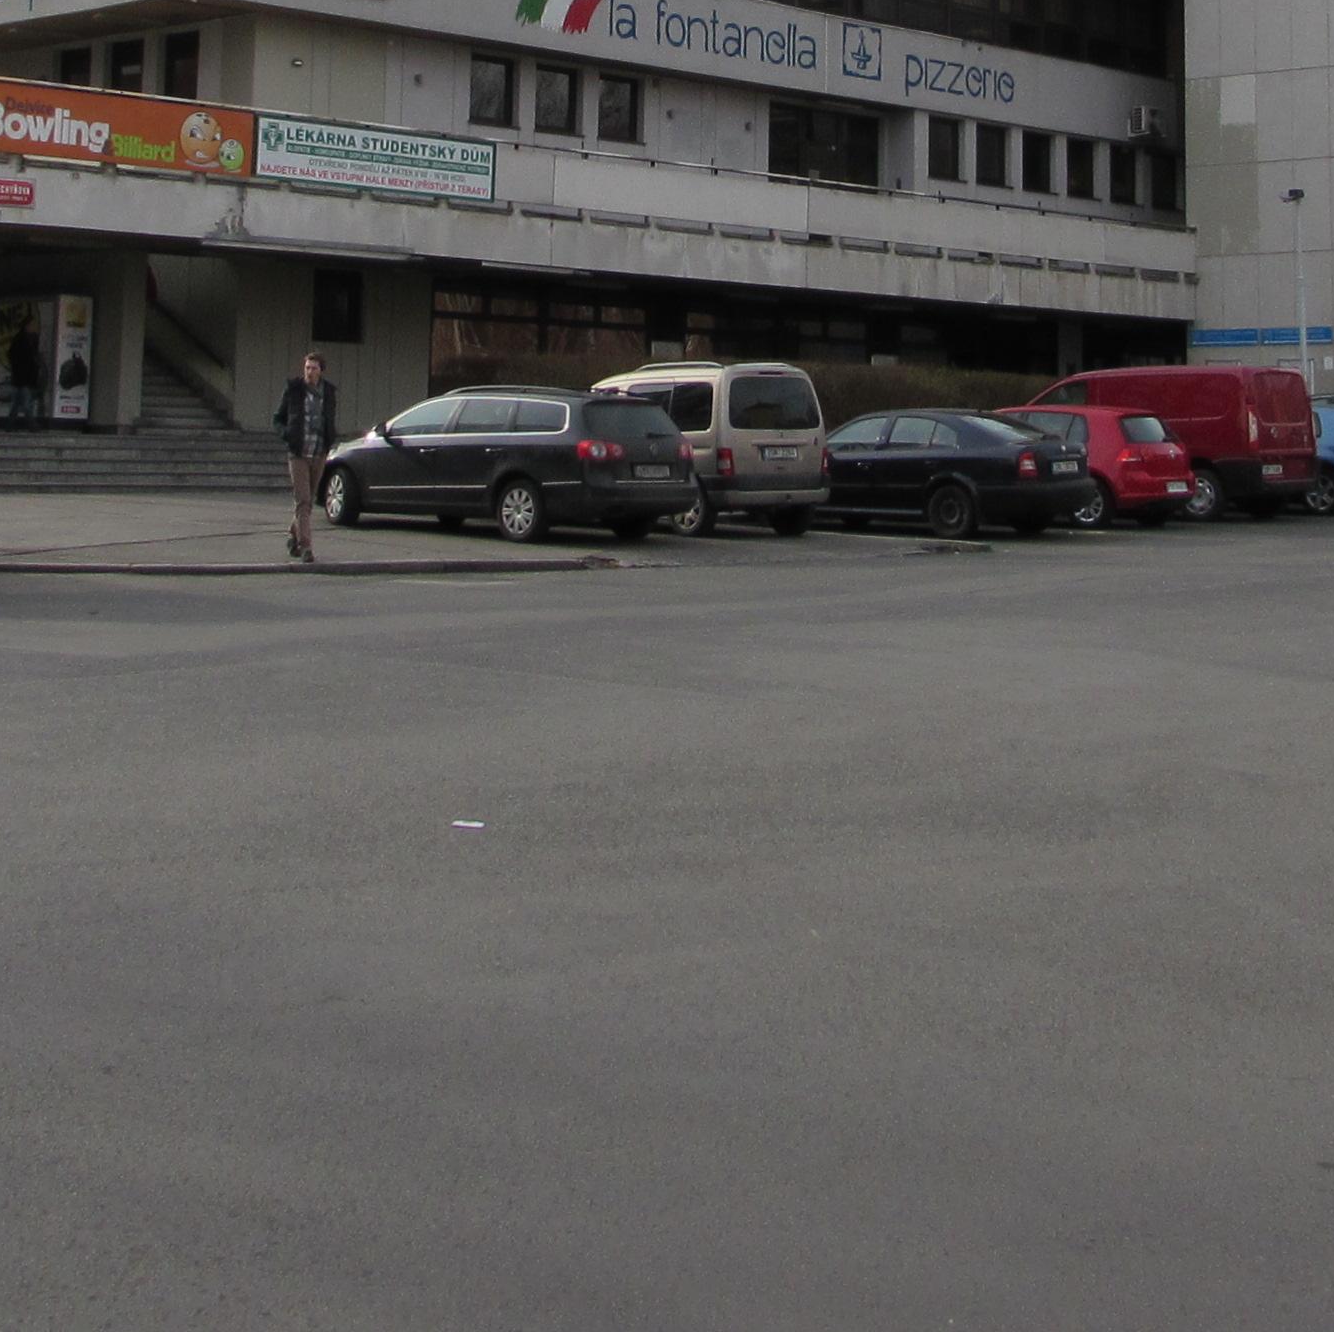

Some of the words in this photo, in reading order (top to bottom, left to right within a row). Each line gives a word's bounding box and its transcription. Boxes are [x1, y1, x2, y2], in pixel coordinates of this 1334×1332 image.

[657, 0, 817, 70] fontanella
[904, 54, 1015, 103] pizzerie
[113, 134, 175, 162] Billiard
[287, 126, 357, 148] LÉKÁRNA
[362, 135, 456, 160] STUDENTSKÝ
